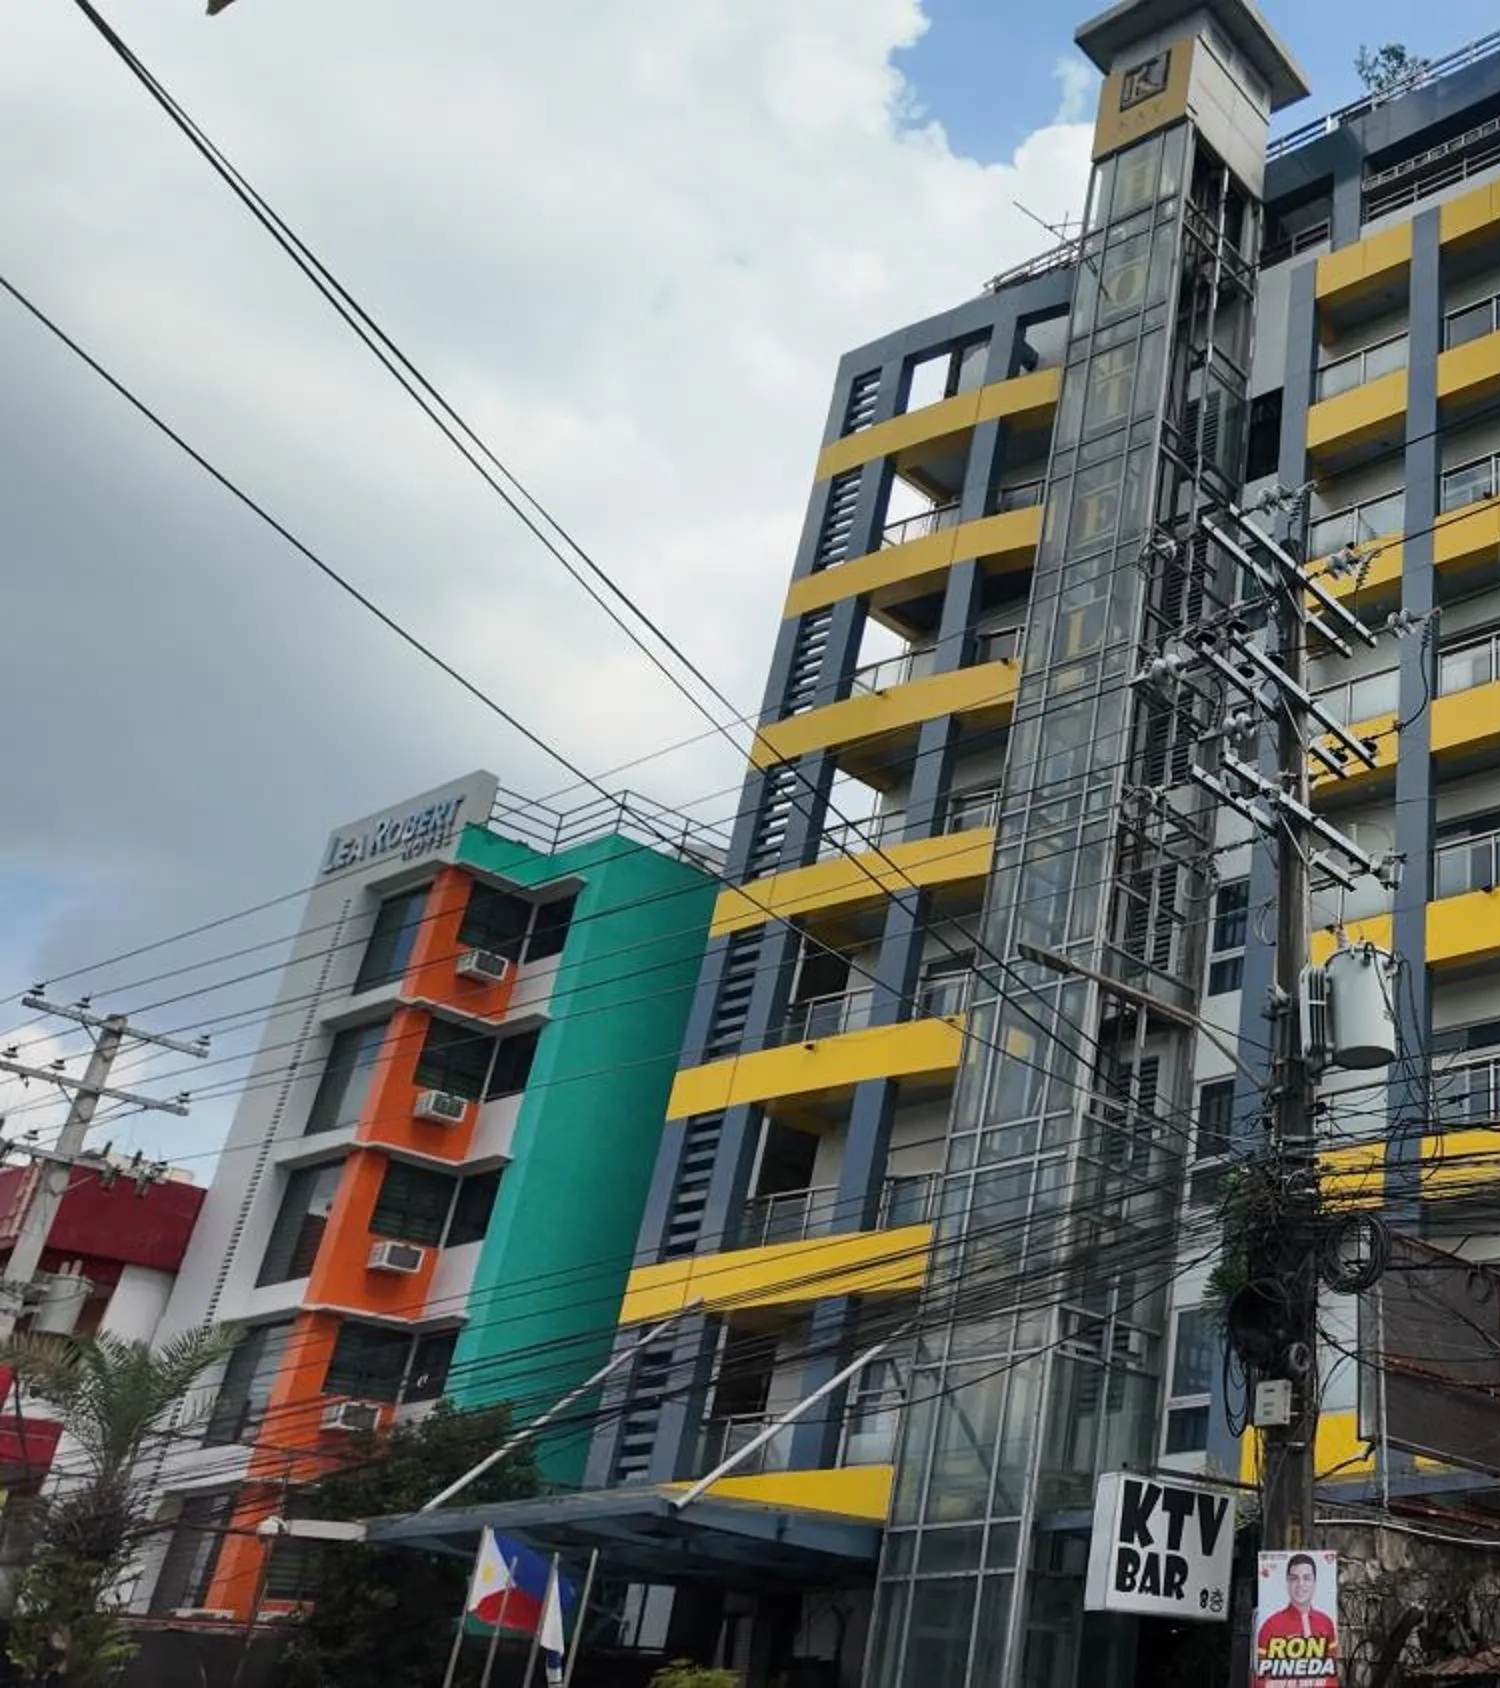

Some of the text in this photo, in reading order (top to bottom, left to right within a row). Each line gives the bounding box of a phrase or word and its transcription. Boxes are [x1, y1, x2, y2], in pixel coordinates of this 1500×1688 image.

[322, 793, 467, 875] LEA ROBERT
[1118, 1480, 1230, 1556] KTV
[1115, 1547, 1189, 1600] BAR
[1258, 1657, 1336, 1677] PINEDA
[1267, 1636, 1327, 1658] RON
